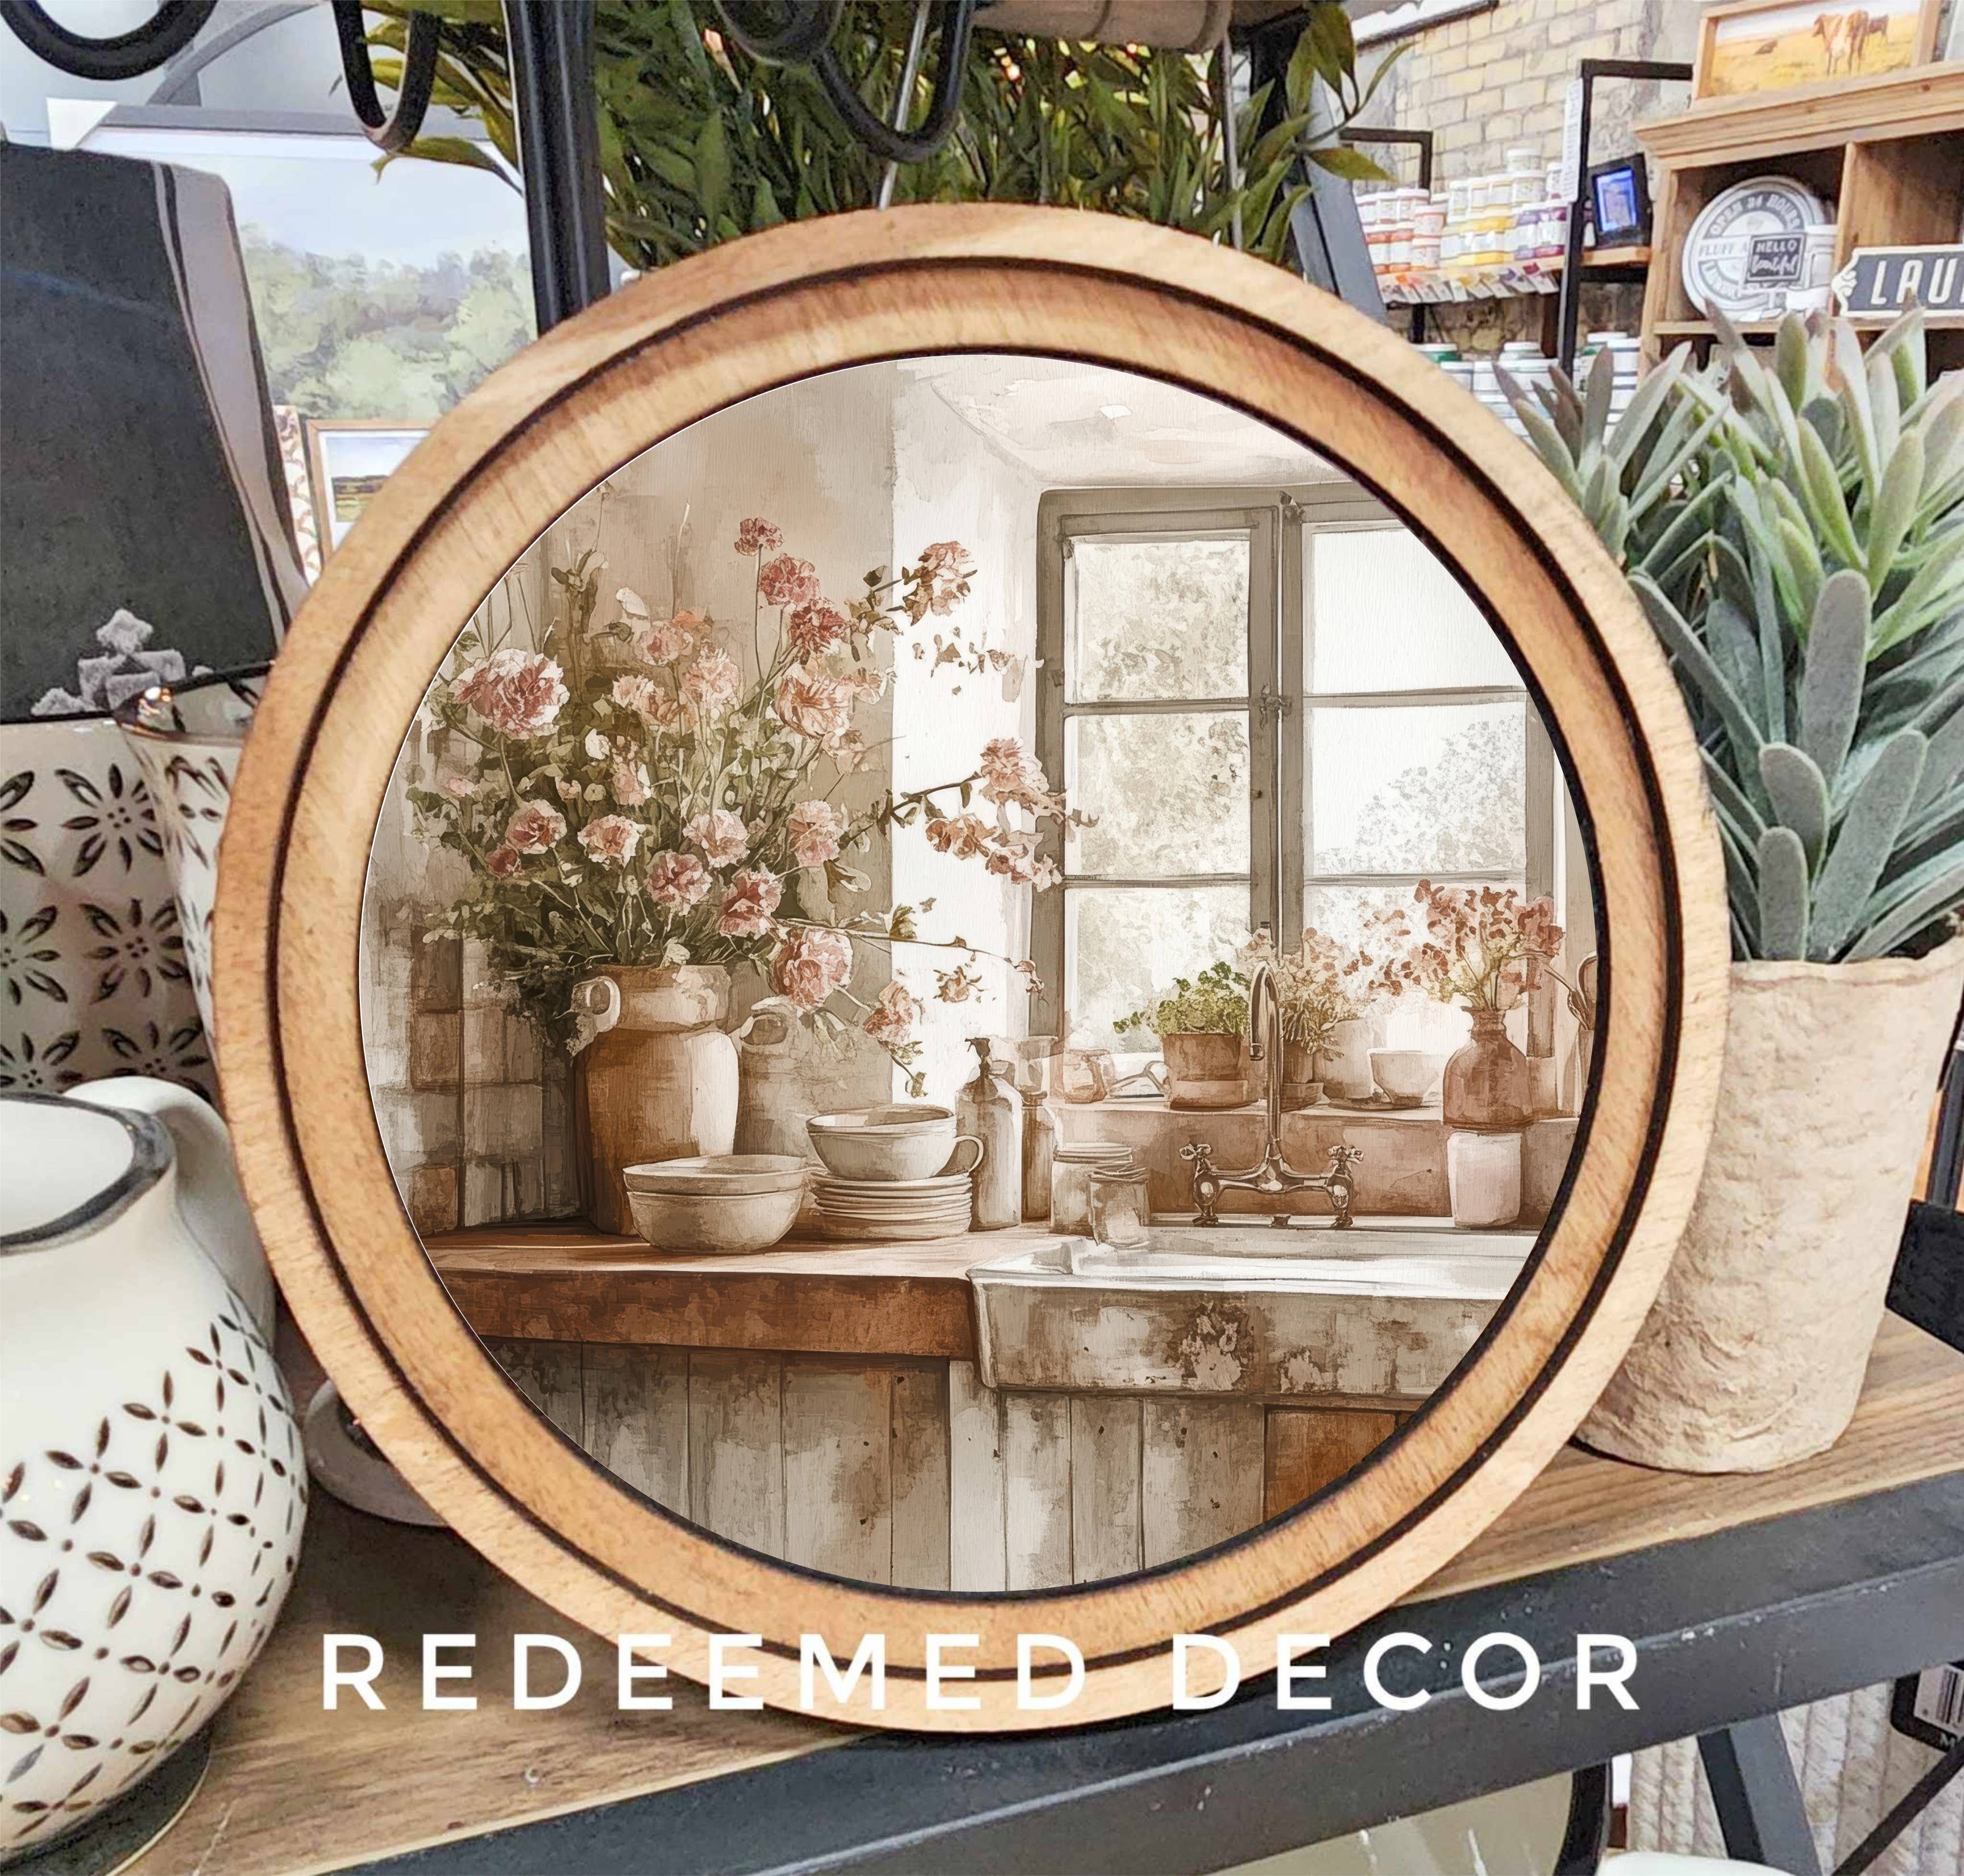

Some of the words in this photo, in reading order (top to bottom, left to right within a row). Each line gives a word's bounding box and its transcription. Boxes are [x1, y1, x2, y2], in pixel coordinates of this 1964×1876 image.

[1709, 199, 1744, 235] OPEN
[1766, 193, 1801, 231] HOURS
[1755, 239, 1797, 252] HELLO
[1870, 257, 1964, 305] LAU
